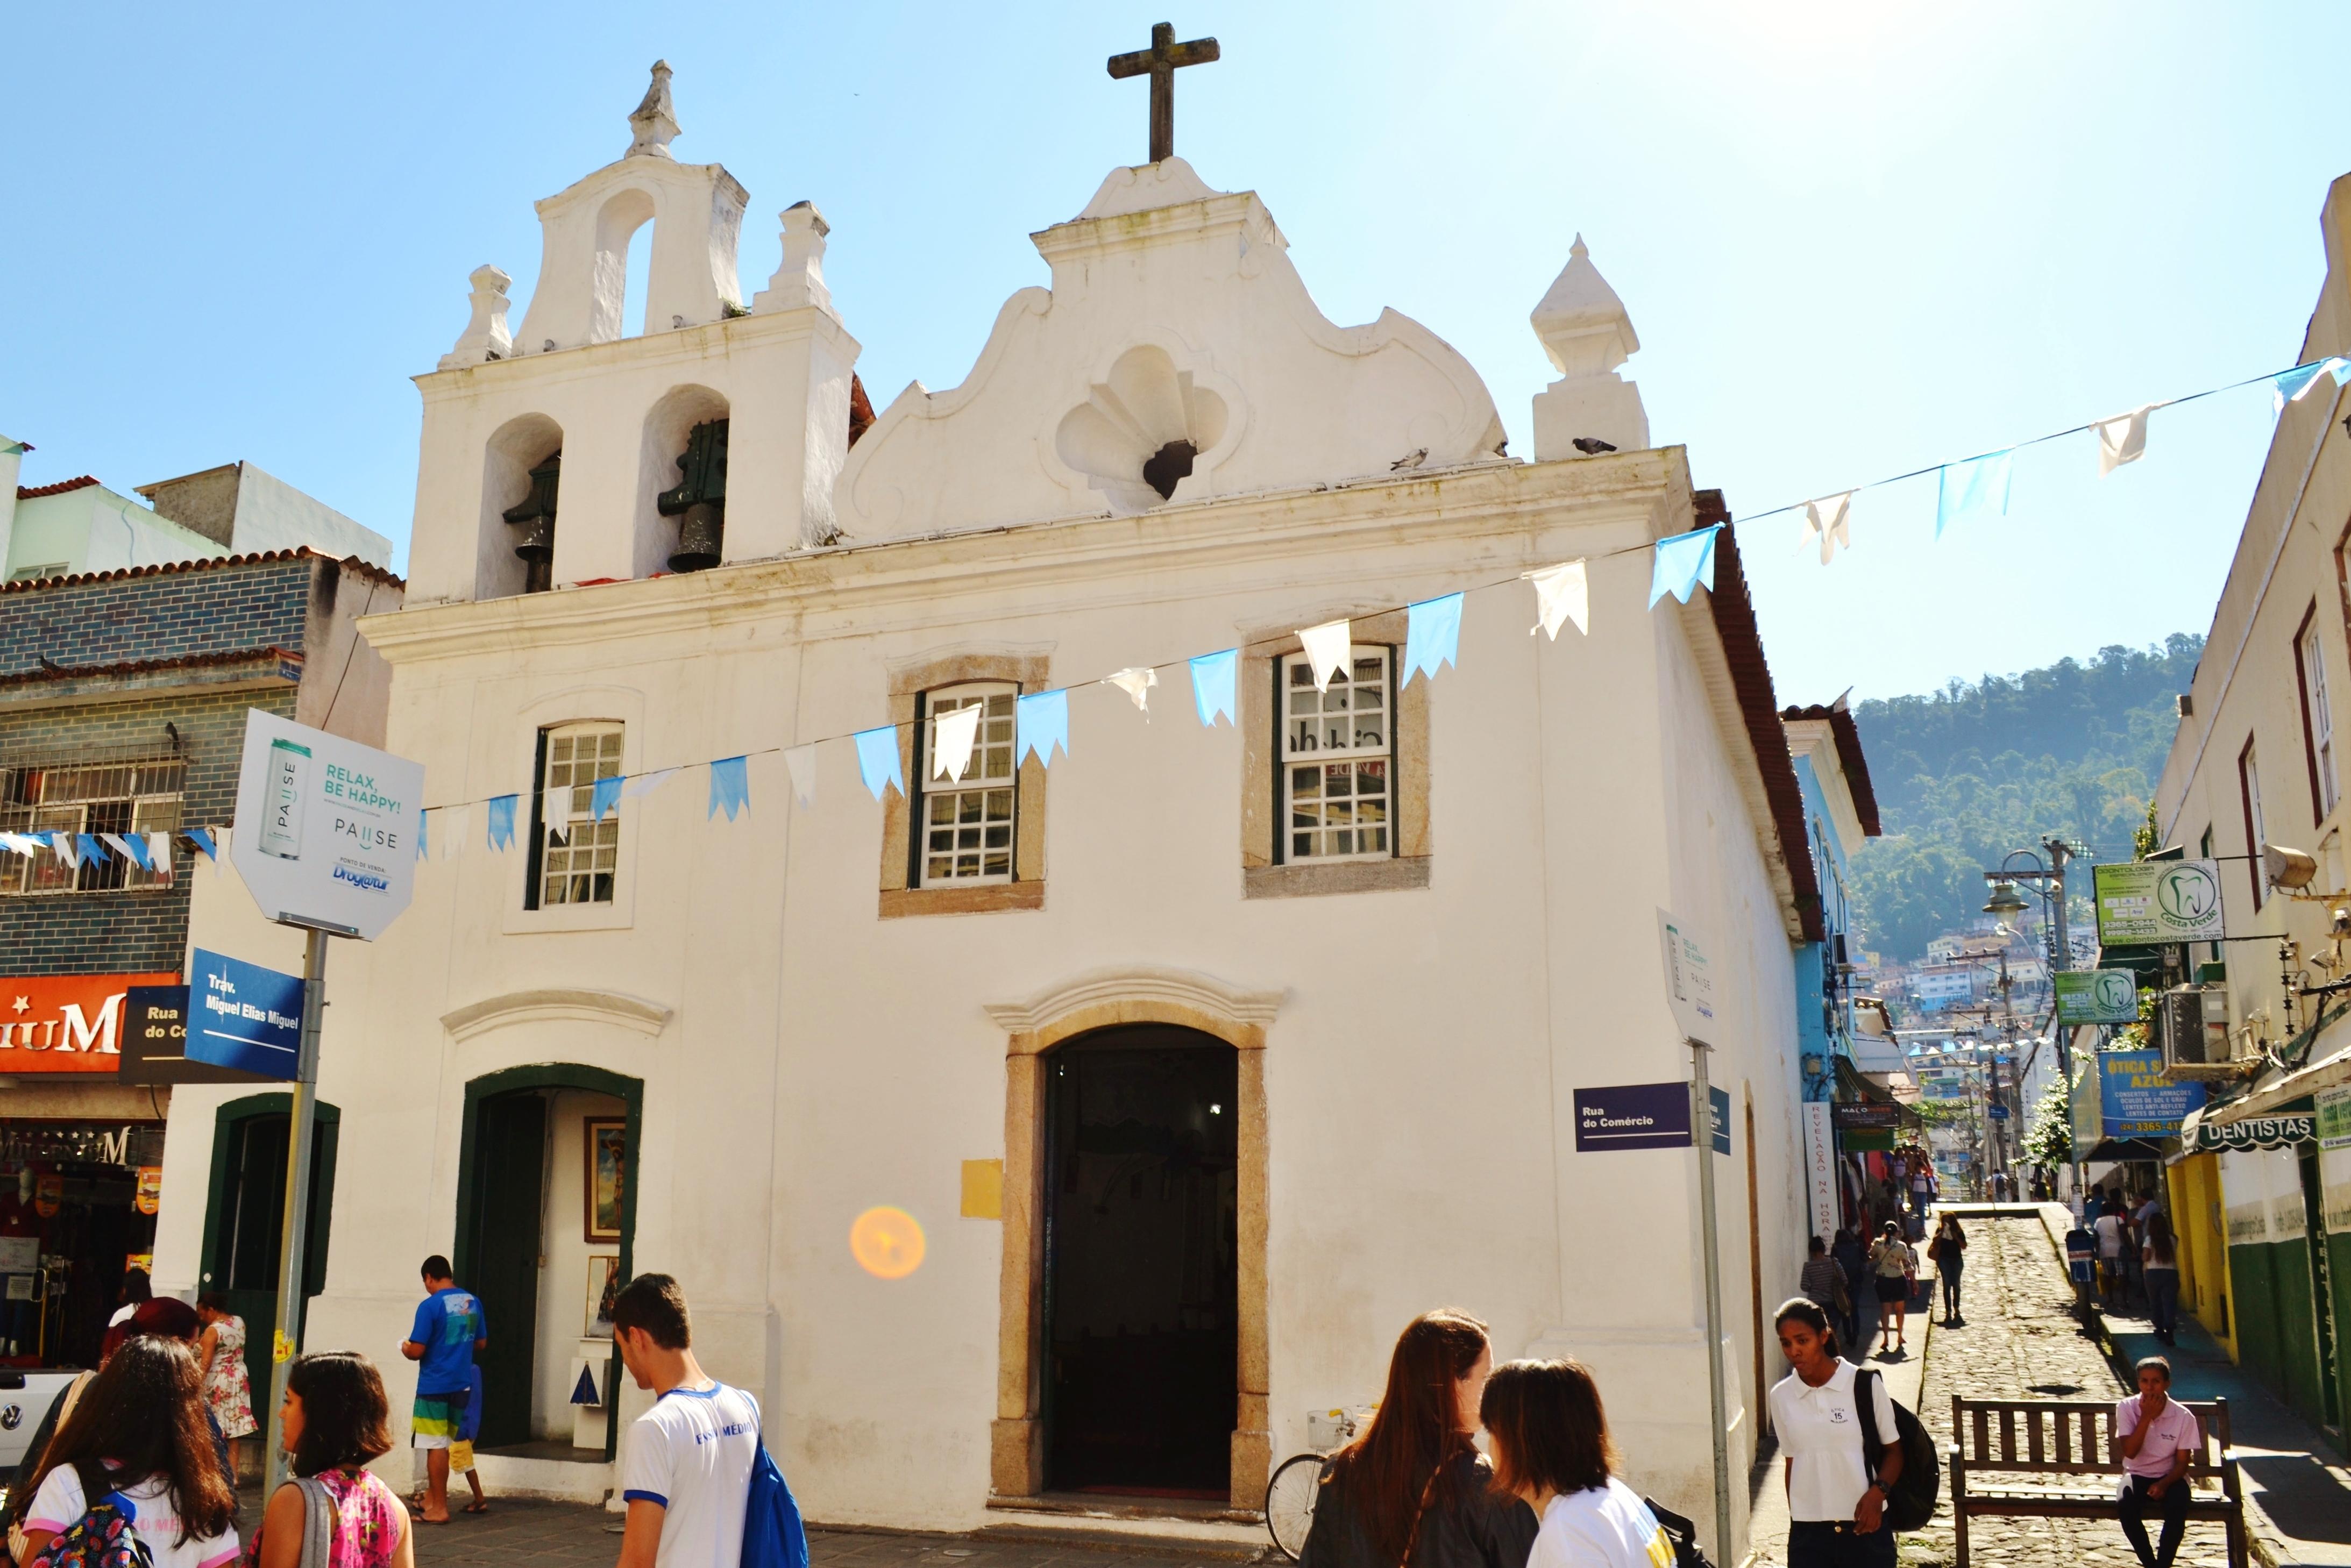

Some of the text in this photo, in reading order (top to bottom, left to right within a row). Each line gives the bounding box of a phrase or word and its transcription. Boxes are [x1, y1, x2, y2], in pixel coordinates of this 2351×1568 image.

[326, 764, 378, 793] RELAX,
[325, 780, 401, 814] BE HAPPY!
[340, 857, 358, 866] PONTO
[367, 864, 387, 873] VENDA:
[2098, 866, 2155, 874] ODONTOLOGIA
[2161, 909, 2218, 928] Costa Verde
[2104, 932, 2222, 944] www.odontocostaverde.com
[2105, 928, 2156, 936] 99952-1433
[208, 973, 236, 994] Trav.
[147, 1007, 178, 1020] Rua
[206, 994, 299, 1029] Miguel Elias Miguel
[145, 1025, 165, 1038] do
[2107, 1058, 2147, 1074] ÓTICA
[2130, 1074, 2176, 1088] AZUL
[1582, 1107, 1604, 1116] Rua
[1583, 1116, 1653, 1128] do Comércio
[2208, 1118, 2311, 1140] DENTISTAS
[1812, 1106, 1826, 1172] REVELAÇÃO
[1819, 1180, 1828, 1194] NA
[1820, 1203, 1830, 1231] HORA
[722, 1422, 752, 1436] MÉDIO
